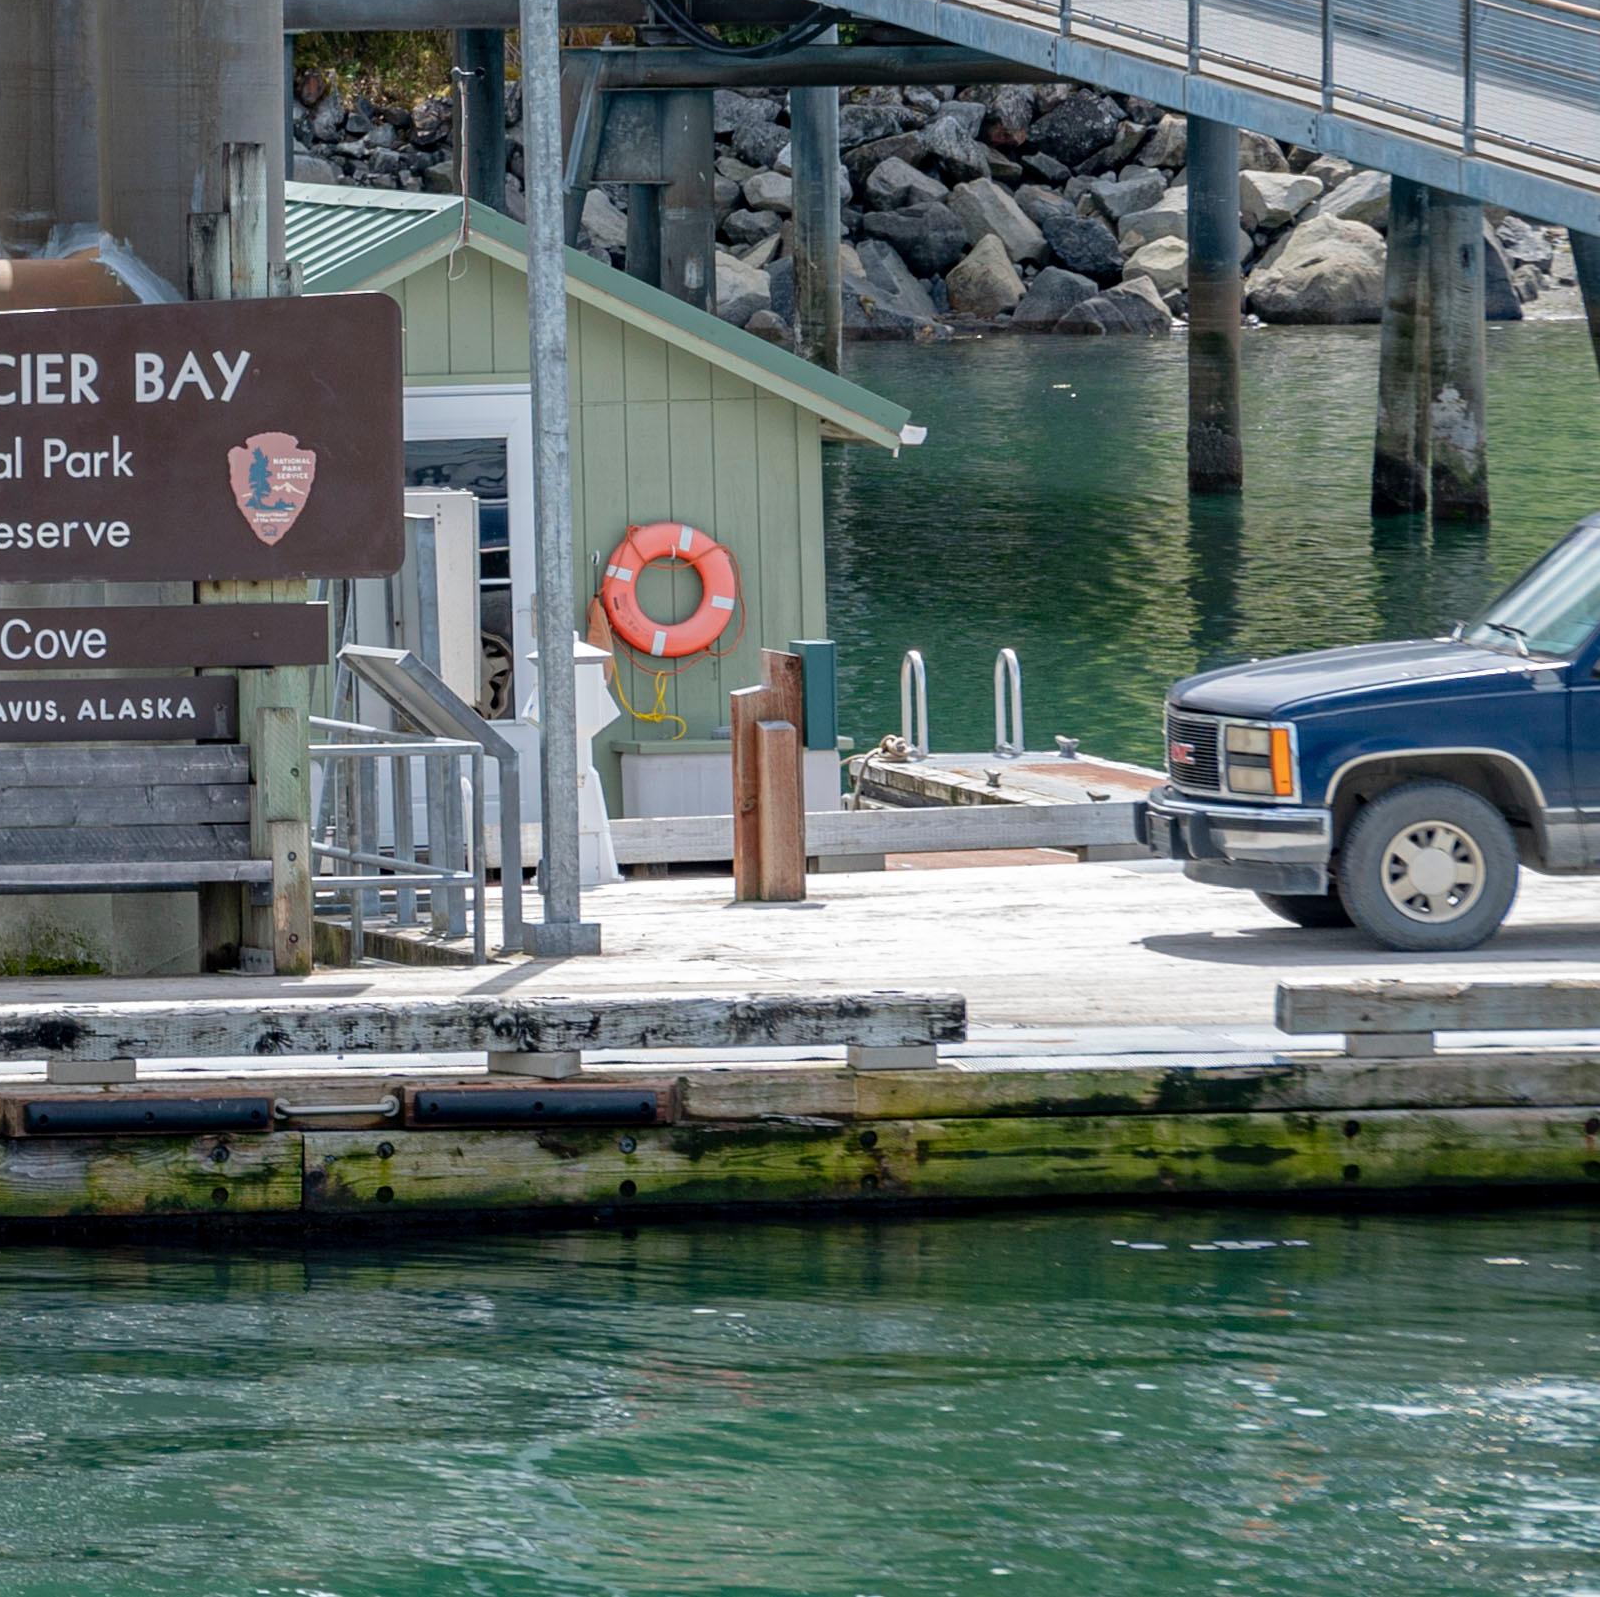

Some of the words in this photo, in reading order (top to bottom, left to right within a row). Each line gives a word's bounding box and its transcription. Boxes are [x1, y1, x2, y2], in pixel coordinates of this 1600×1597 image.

[135, 350, 251, 403] BAY
[43, 435, 134, 478] Park
[272, 457, 312, 465] NATIONAL
[276, 472, 309, 480] SERVICE
[0, 618, 107, 660] Cove
[77, 697, 196, 721] ALASKA
